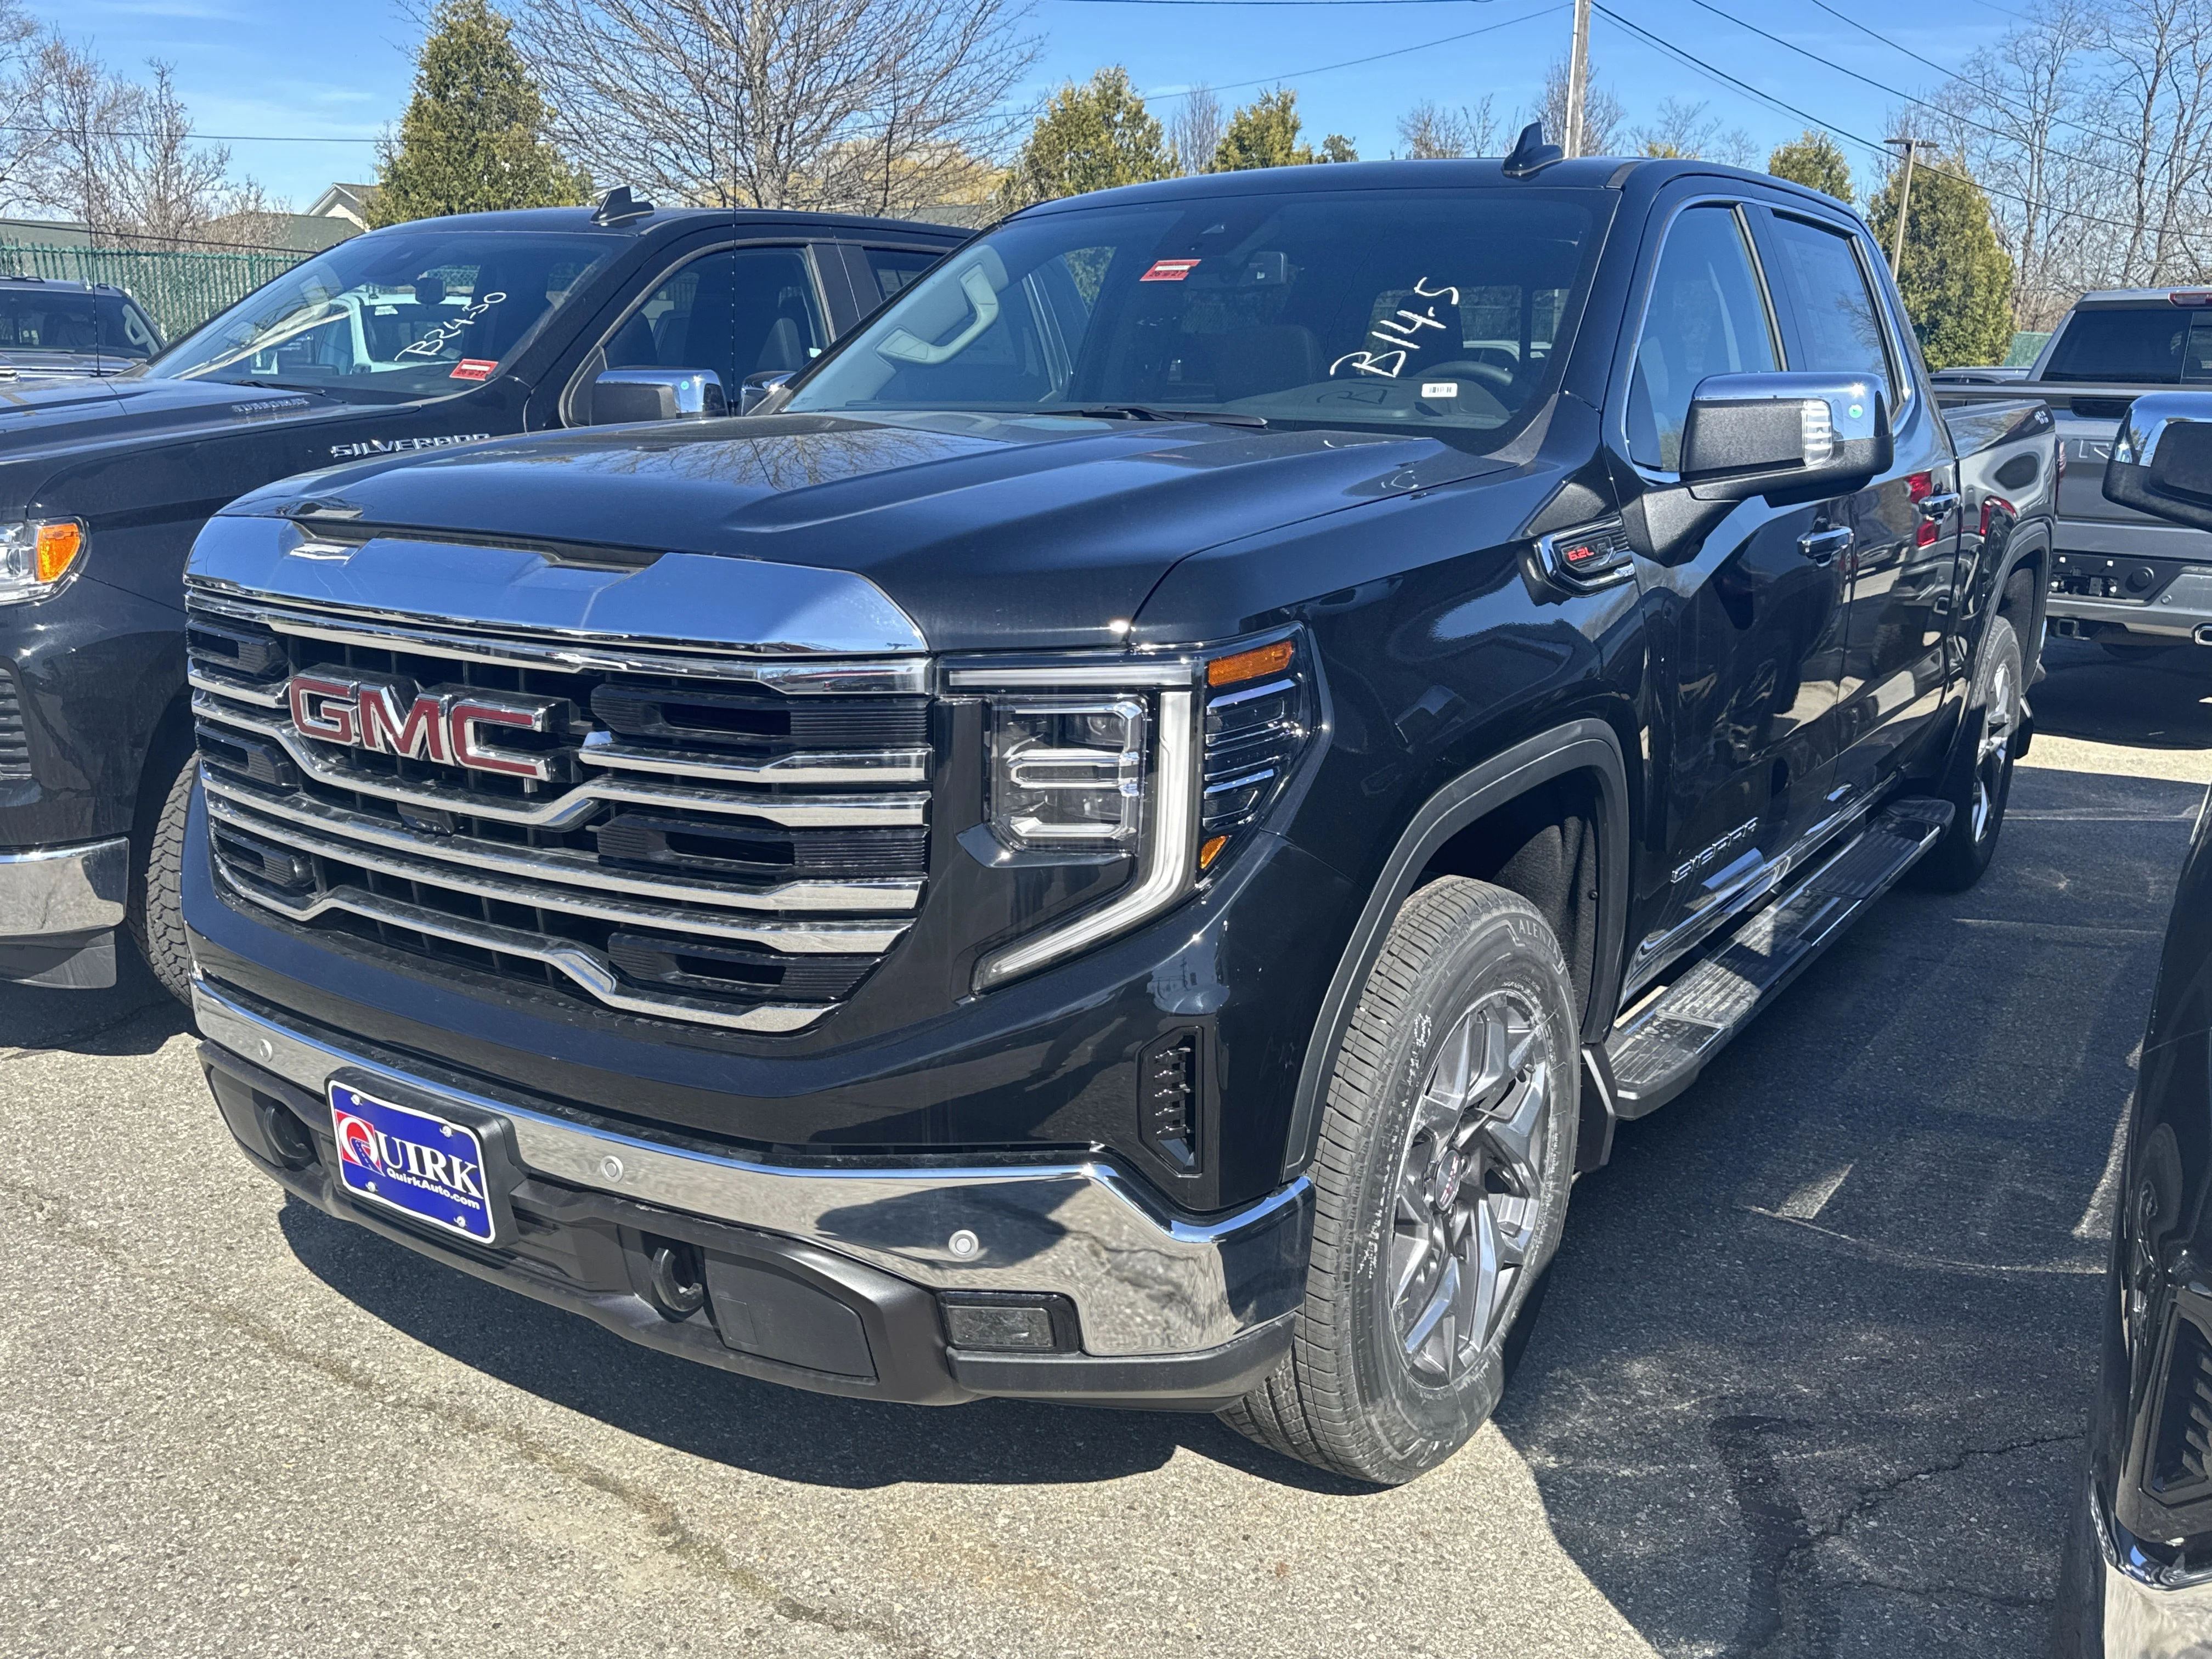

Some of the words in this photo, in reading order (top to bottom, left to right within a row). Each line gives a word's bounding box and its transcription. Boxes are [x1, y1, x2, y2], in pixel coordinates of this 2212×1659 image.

[290, 675, 551, 782] GMC
[1519, 919, 1559, 960] ALENZA
[338, 1116, 484, 1200] QUIRK
[386, 1167, 481, 1210] QuirkAuto.com
